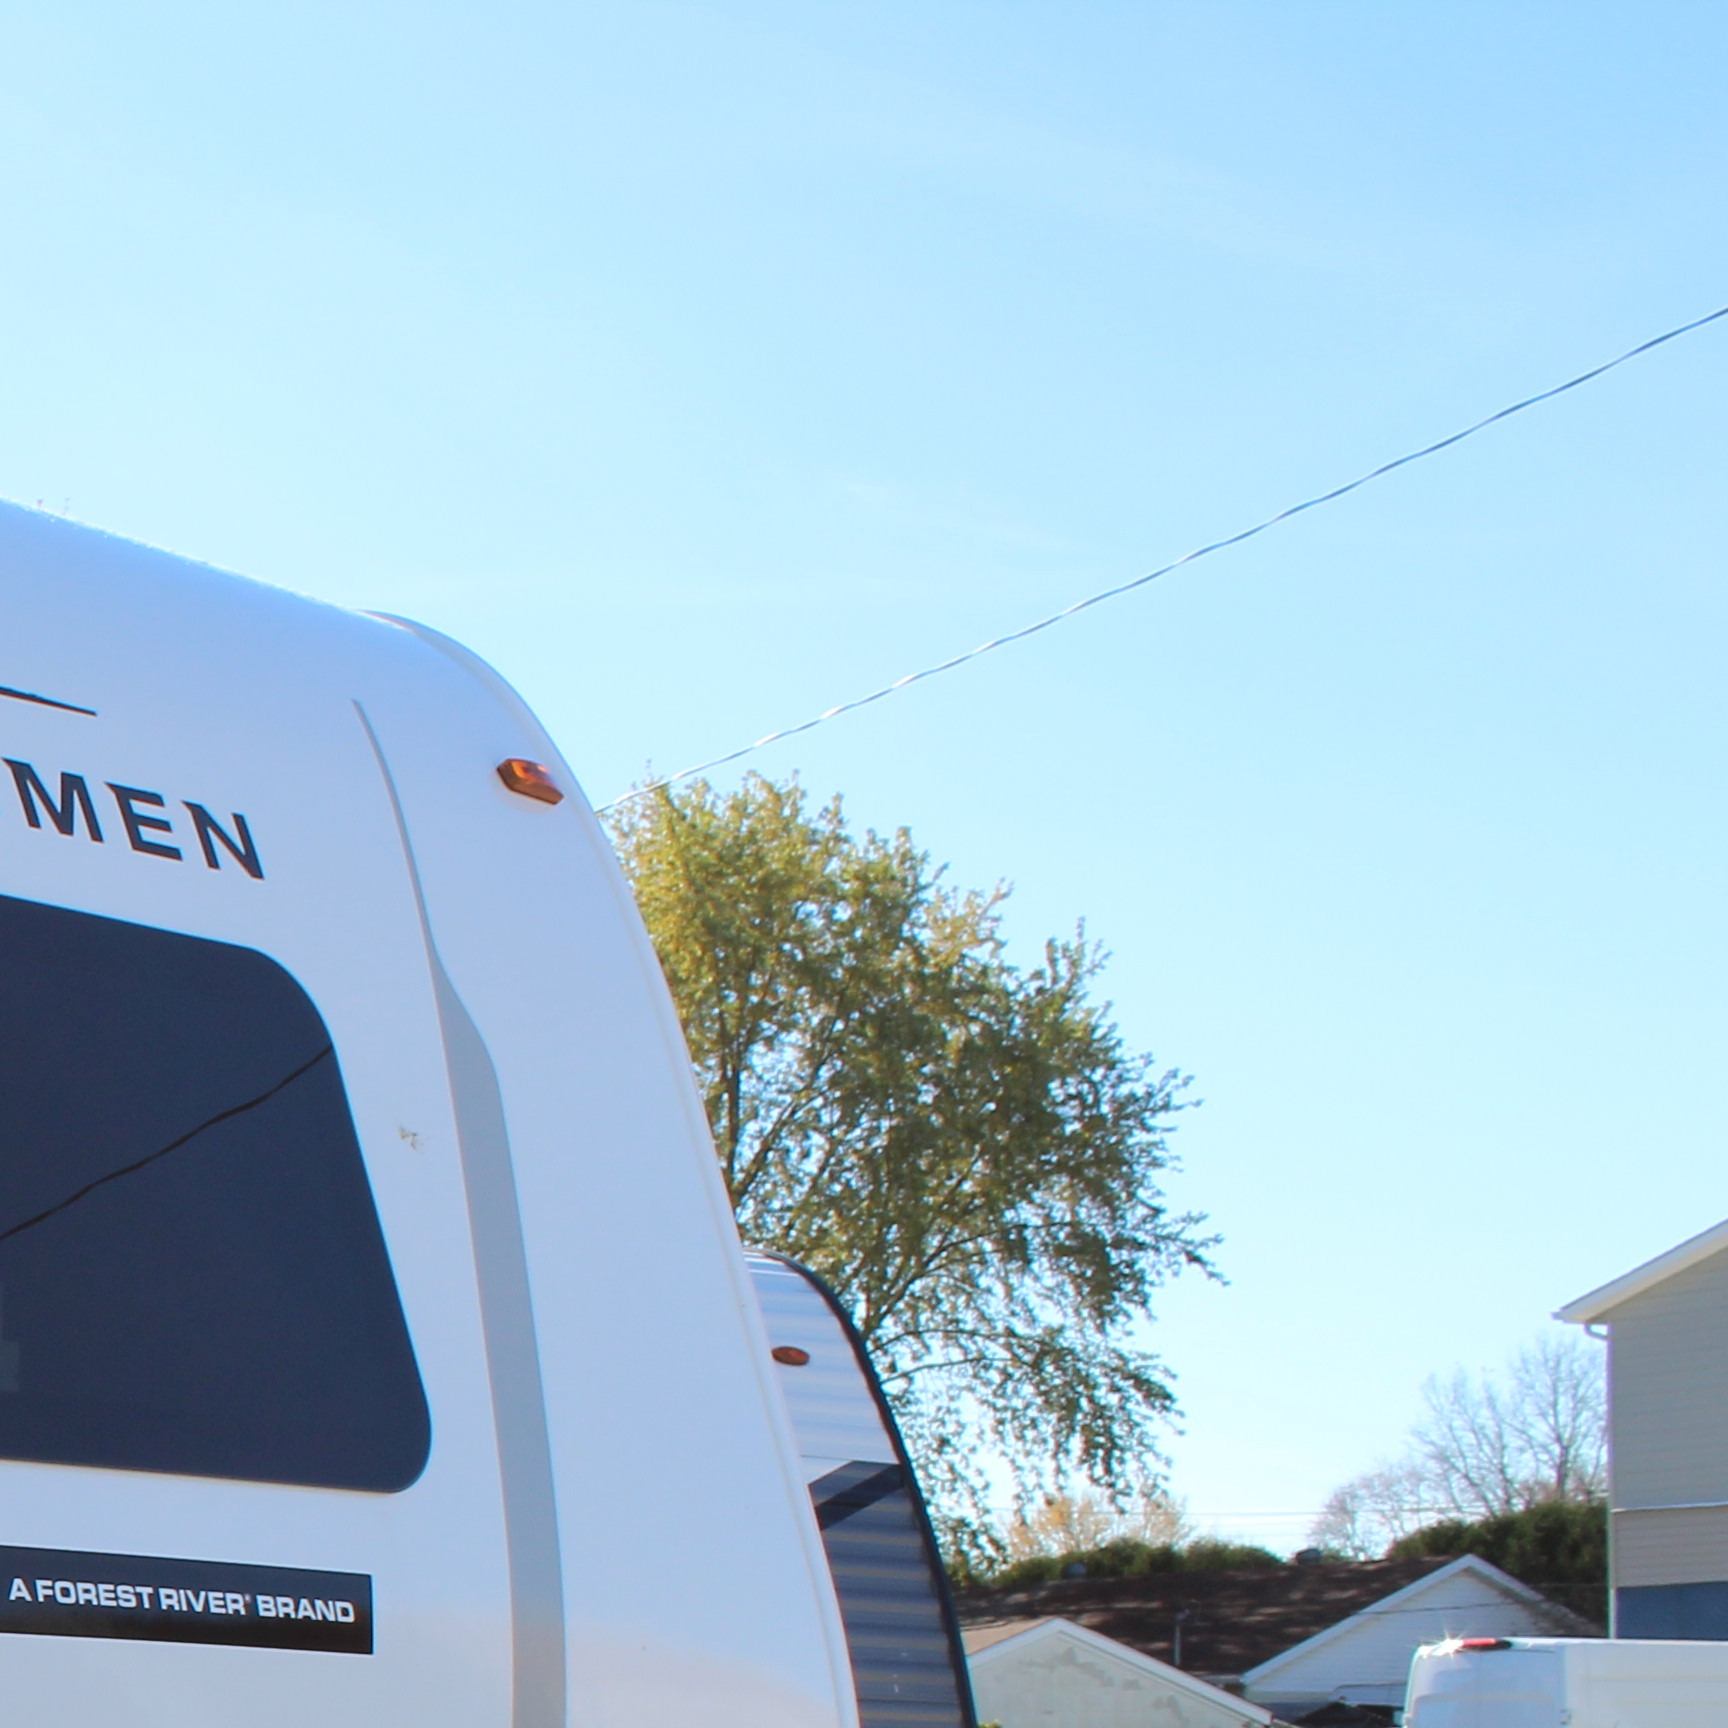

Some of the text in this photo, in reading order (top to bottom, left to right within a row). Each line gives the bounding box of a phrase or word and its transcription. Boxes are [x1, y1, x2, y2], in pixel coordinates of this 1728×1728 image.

[8, 1577, 33, 1602] A
[36, 1579, 154, 1611] FOREST
[255, 1594, 356, 1625] BRAND
